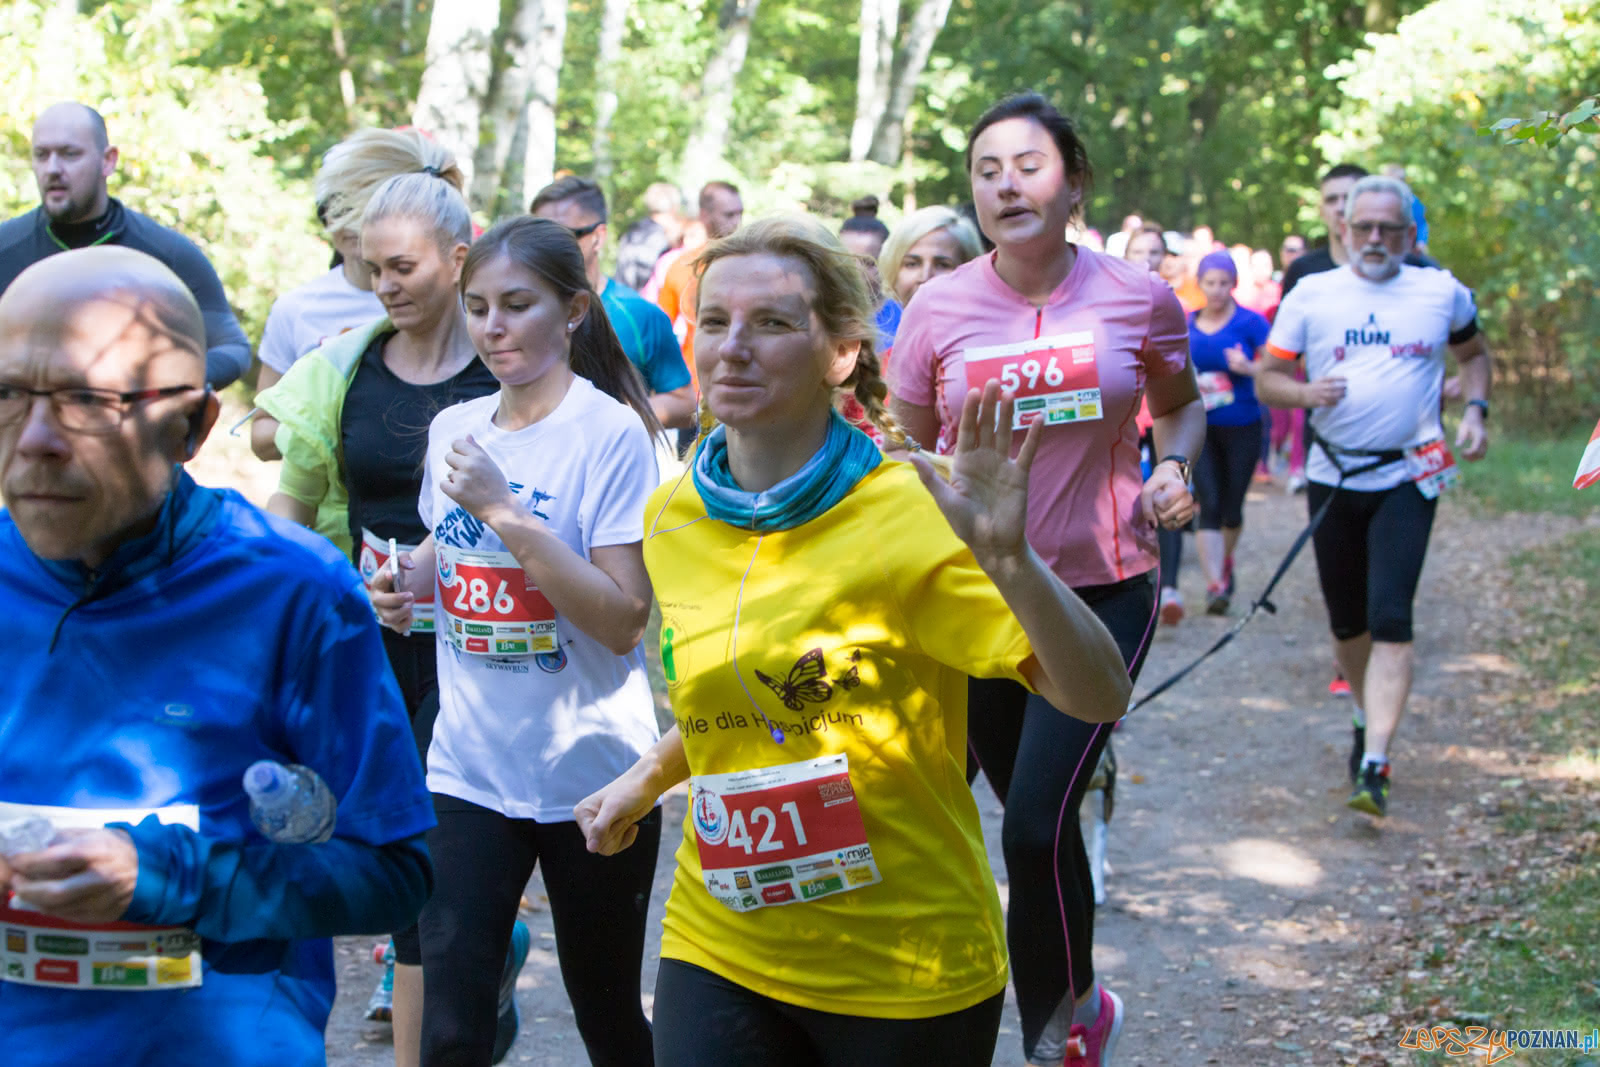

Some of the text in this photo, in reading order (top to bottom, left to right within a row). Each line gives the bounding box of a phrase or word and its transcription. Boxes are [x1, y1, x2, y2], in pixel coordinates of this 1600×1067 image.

[1000, 357, 1064, 393] 596
[453, 575, 514, 615] 286
[715, 711, 749, 731] dla
[727, 801, 808, 855] 421
